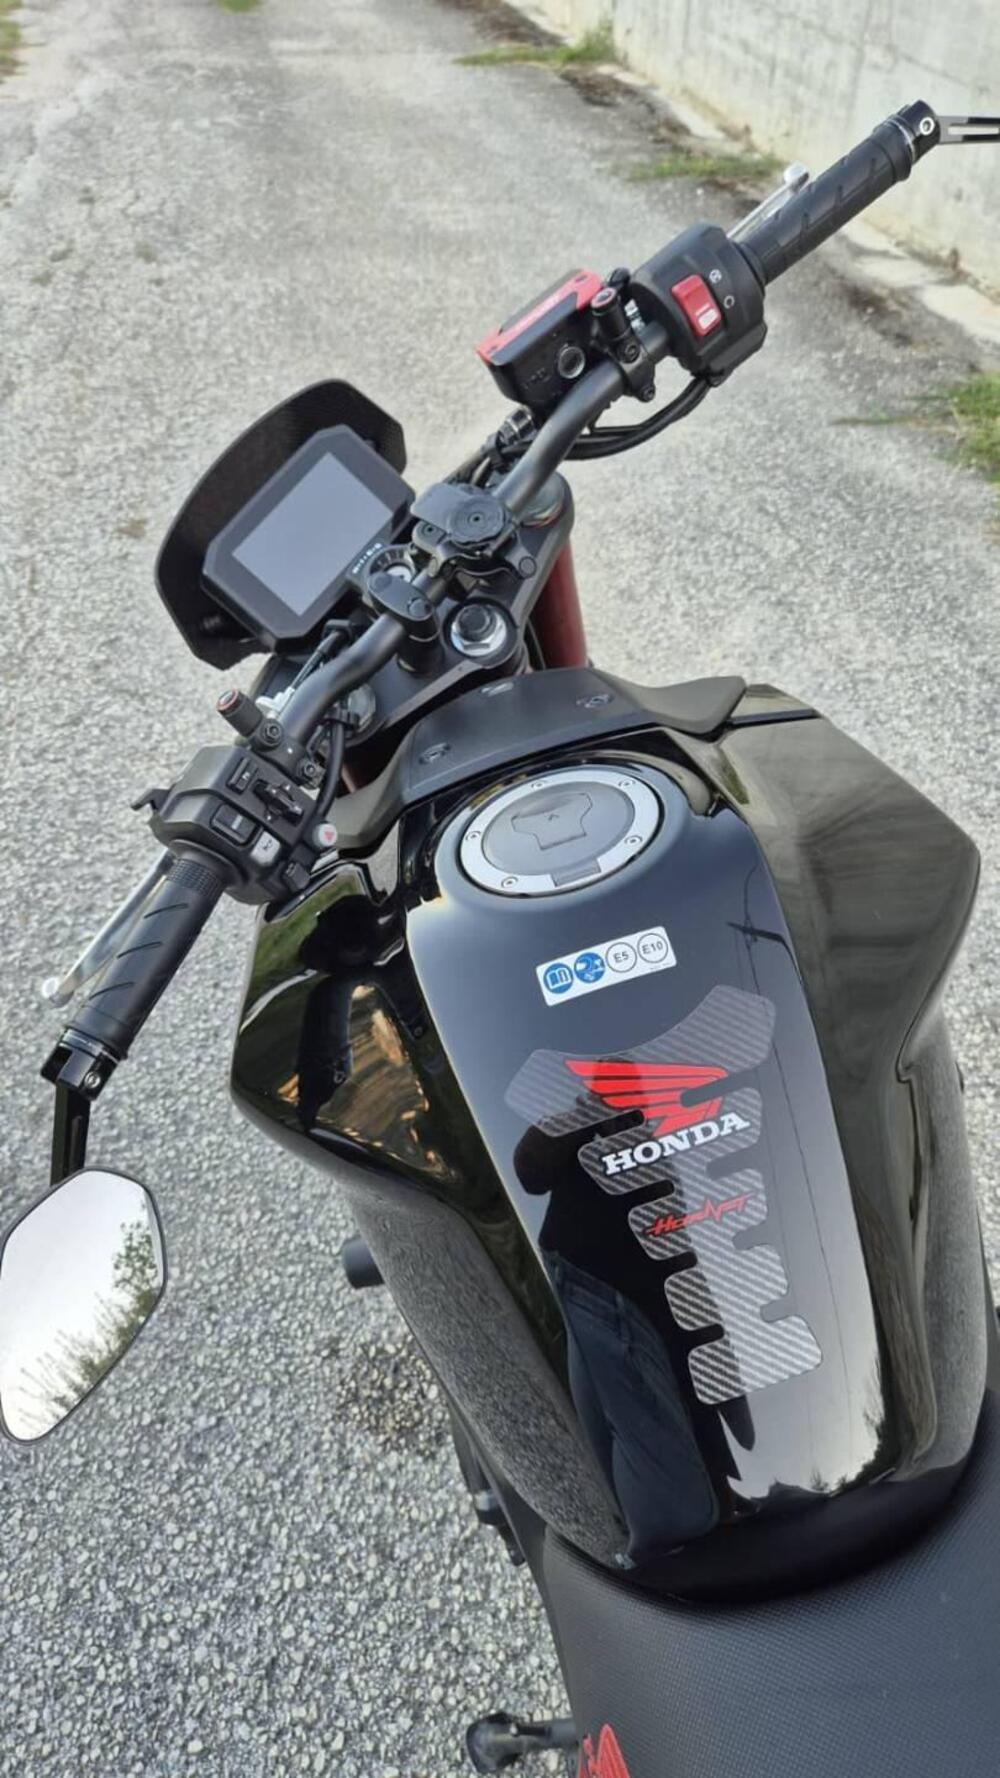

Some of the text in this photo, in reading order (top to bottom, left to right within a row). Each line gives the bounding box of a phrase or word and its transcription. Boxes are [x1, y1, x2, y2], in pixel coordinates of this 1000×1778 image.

[613, 940, 664, 963] E5 E10
[602, 1112, 750, 1175] HONDA
